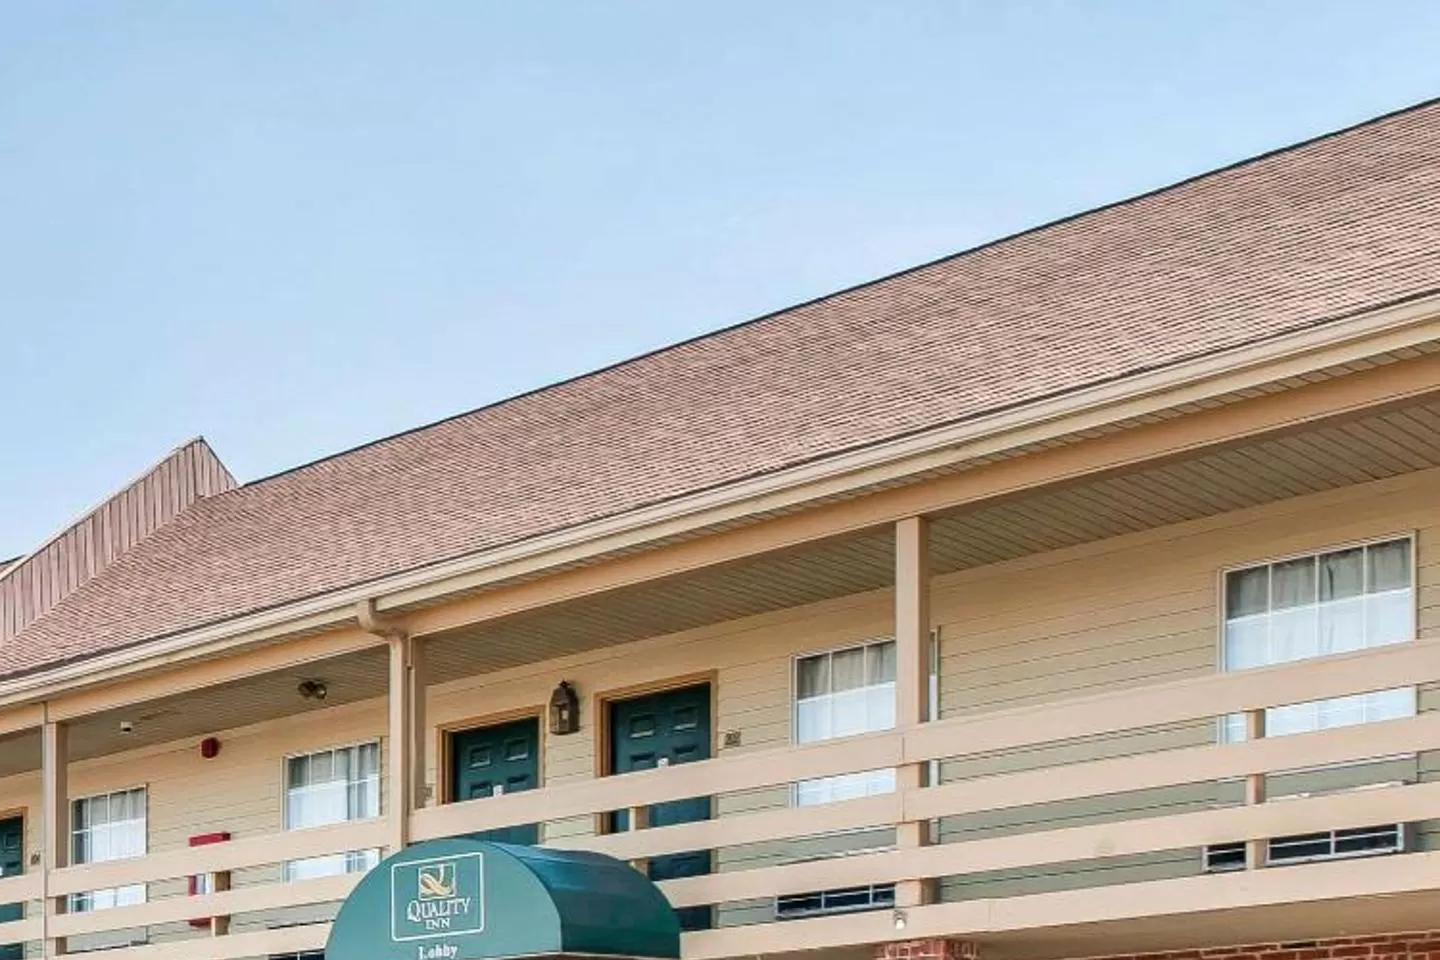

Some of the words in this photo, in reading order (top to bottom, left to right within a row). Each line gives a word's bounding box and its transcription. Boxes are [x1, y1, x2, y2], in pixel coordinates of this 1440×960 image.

[407, 897, 471, 922] QUALITY
[425, 917, 451, 930] INN
[418, 943, 458, 960] Lobby
